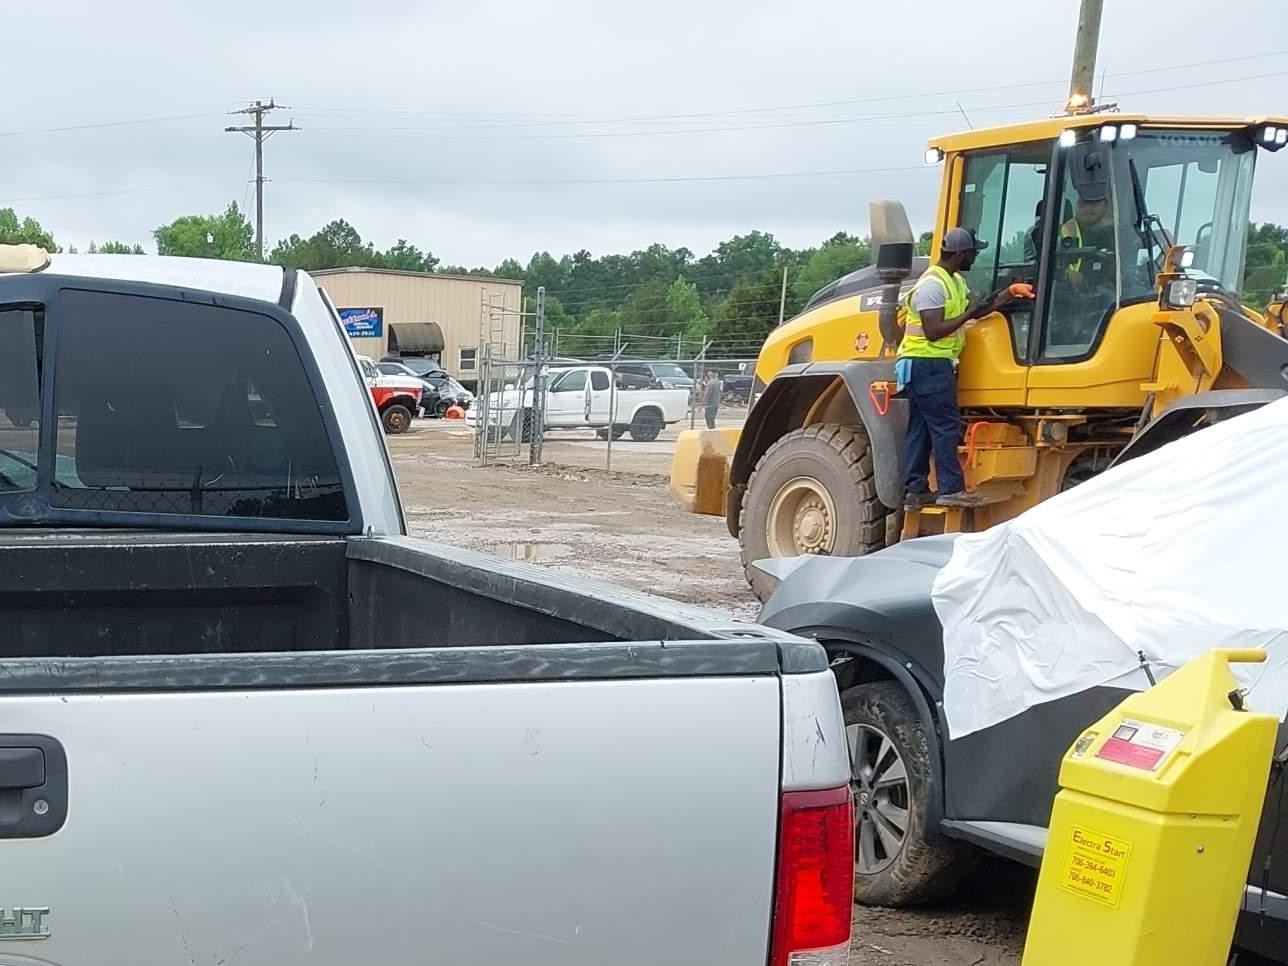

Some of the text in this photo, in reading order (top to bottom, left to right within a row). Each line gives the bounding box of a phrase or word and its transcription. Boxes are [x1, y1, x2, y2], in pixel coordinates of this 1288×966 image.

[1157, 135, 1223, 146] VOLVO
[1073, 830, 1102, 851] Electra
[1102, 840, 1126, 859] Start
